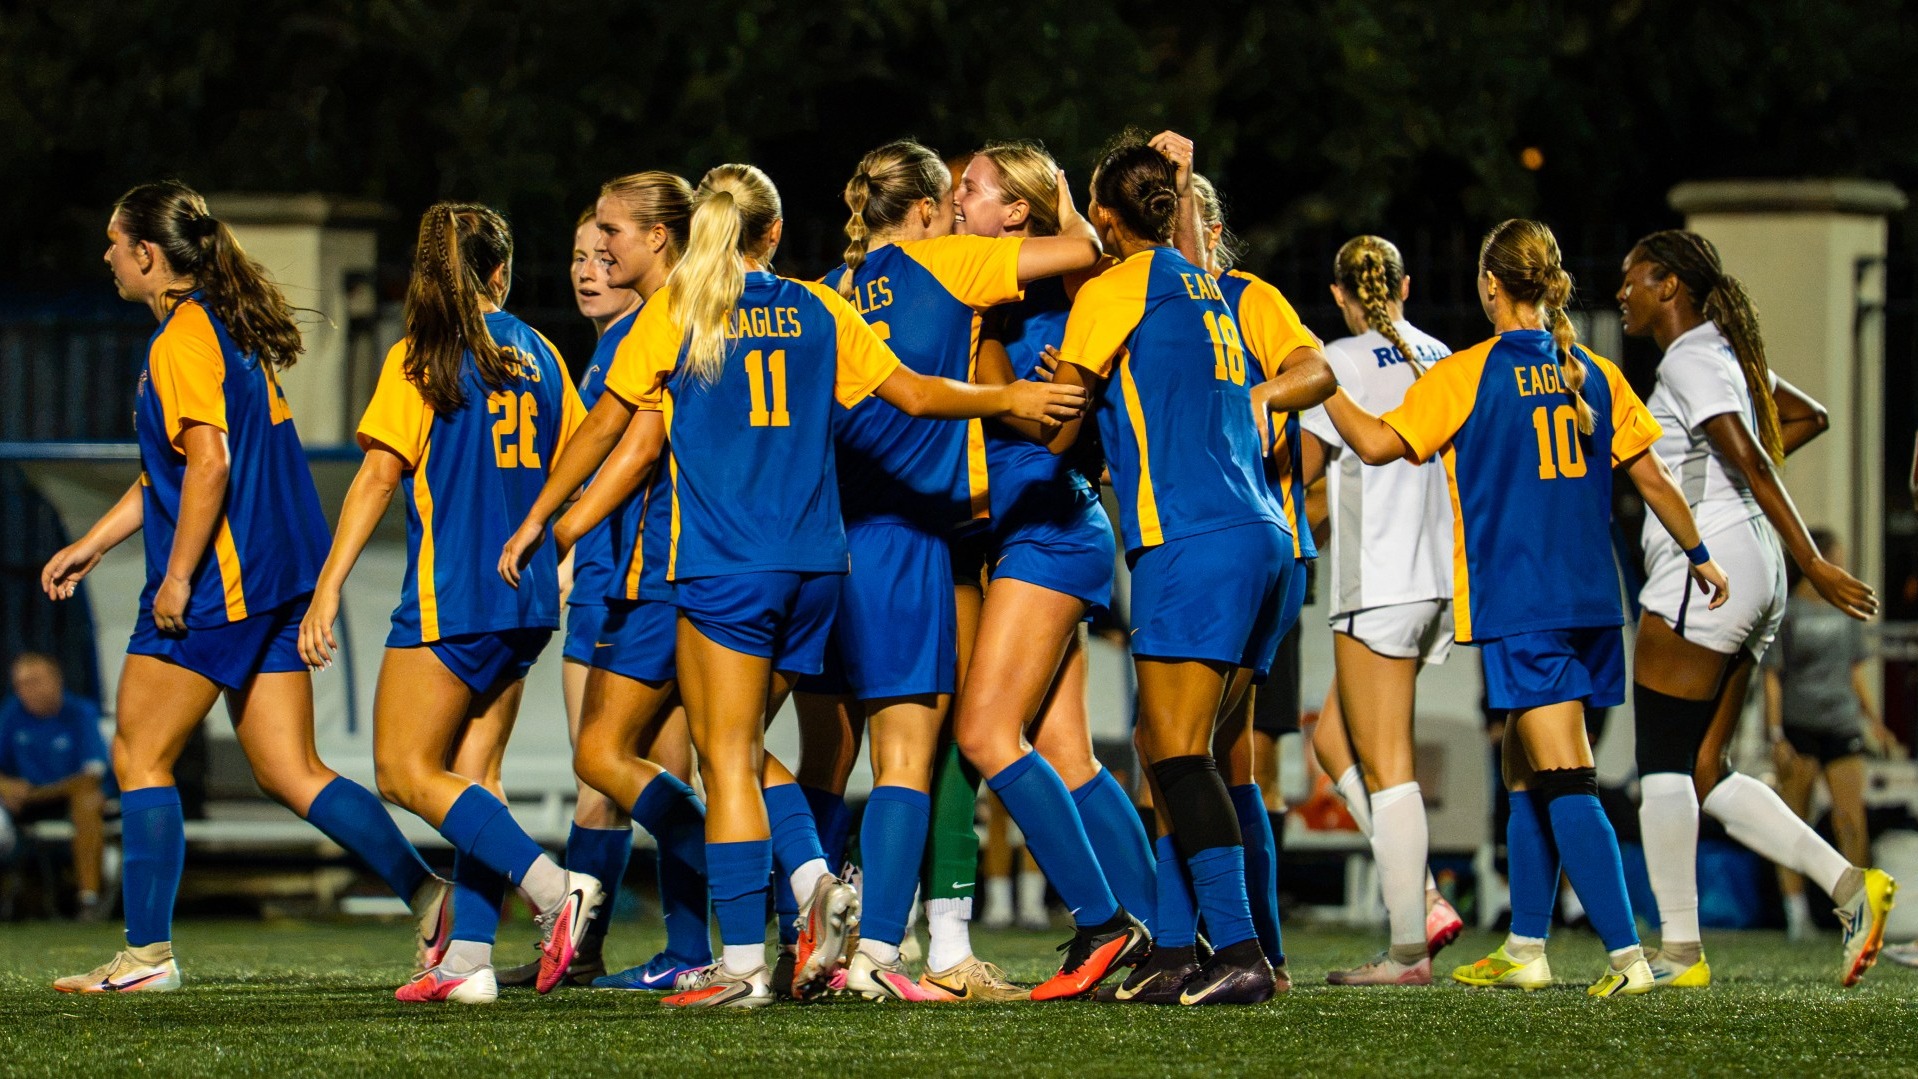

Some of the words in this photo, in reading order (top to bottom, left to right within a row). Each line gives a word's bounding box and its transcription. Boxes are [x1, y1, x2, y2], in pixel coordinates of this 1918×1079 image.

[1180, 273, 1222, 300] EAG
[1203, 310, 1246, 386] 18
[1514, 364, 1566, 397] EAGL
[744, 349, 790, 427] 11
[487, 390, 541, 468] 26
[1532, 404, 1587, 480] 10
